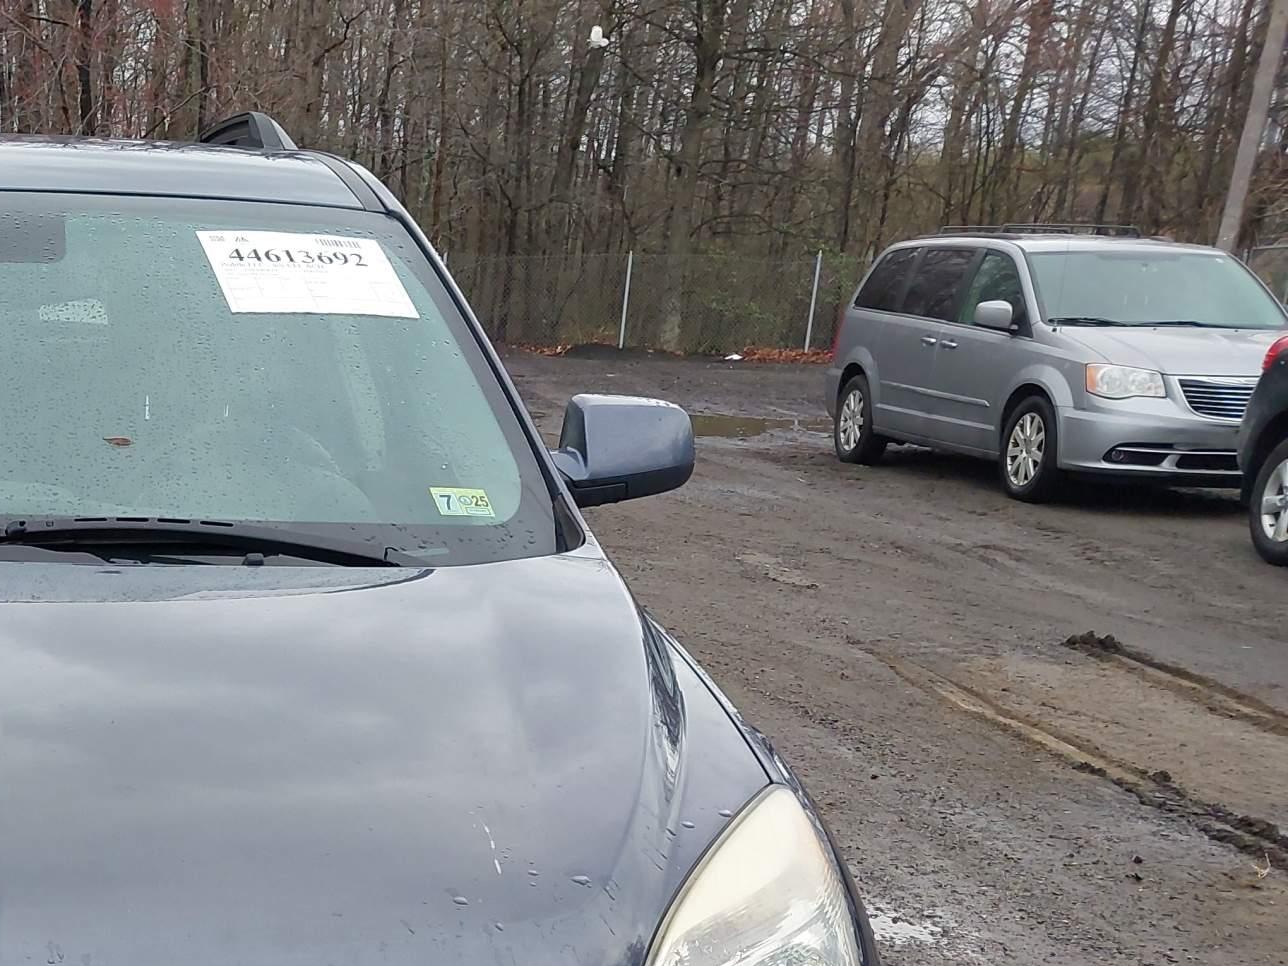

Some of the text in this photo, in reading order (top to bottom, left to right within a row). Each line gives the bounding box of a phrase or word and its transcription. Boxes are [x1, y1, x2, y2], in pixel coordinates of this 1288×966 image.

[228, 248, 368, 267] 44613692
[439, 494, 489, 511] 7 25
